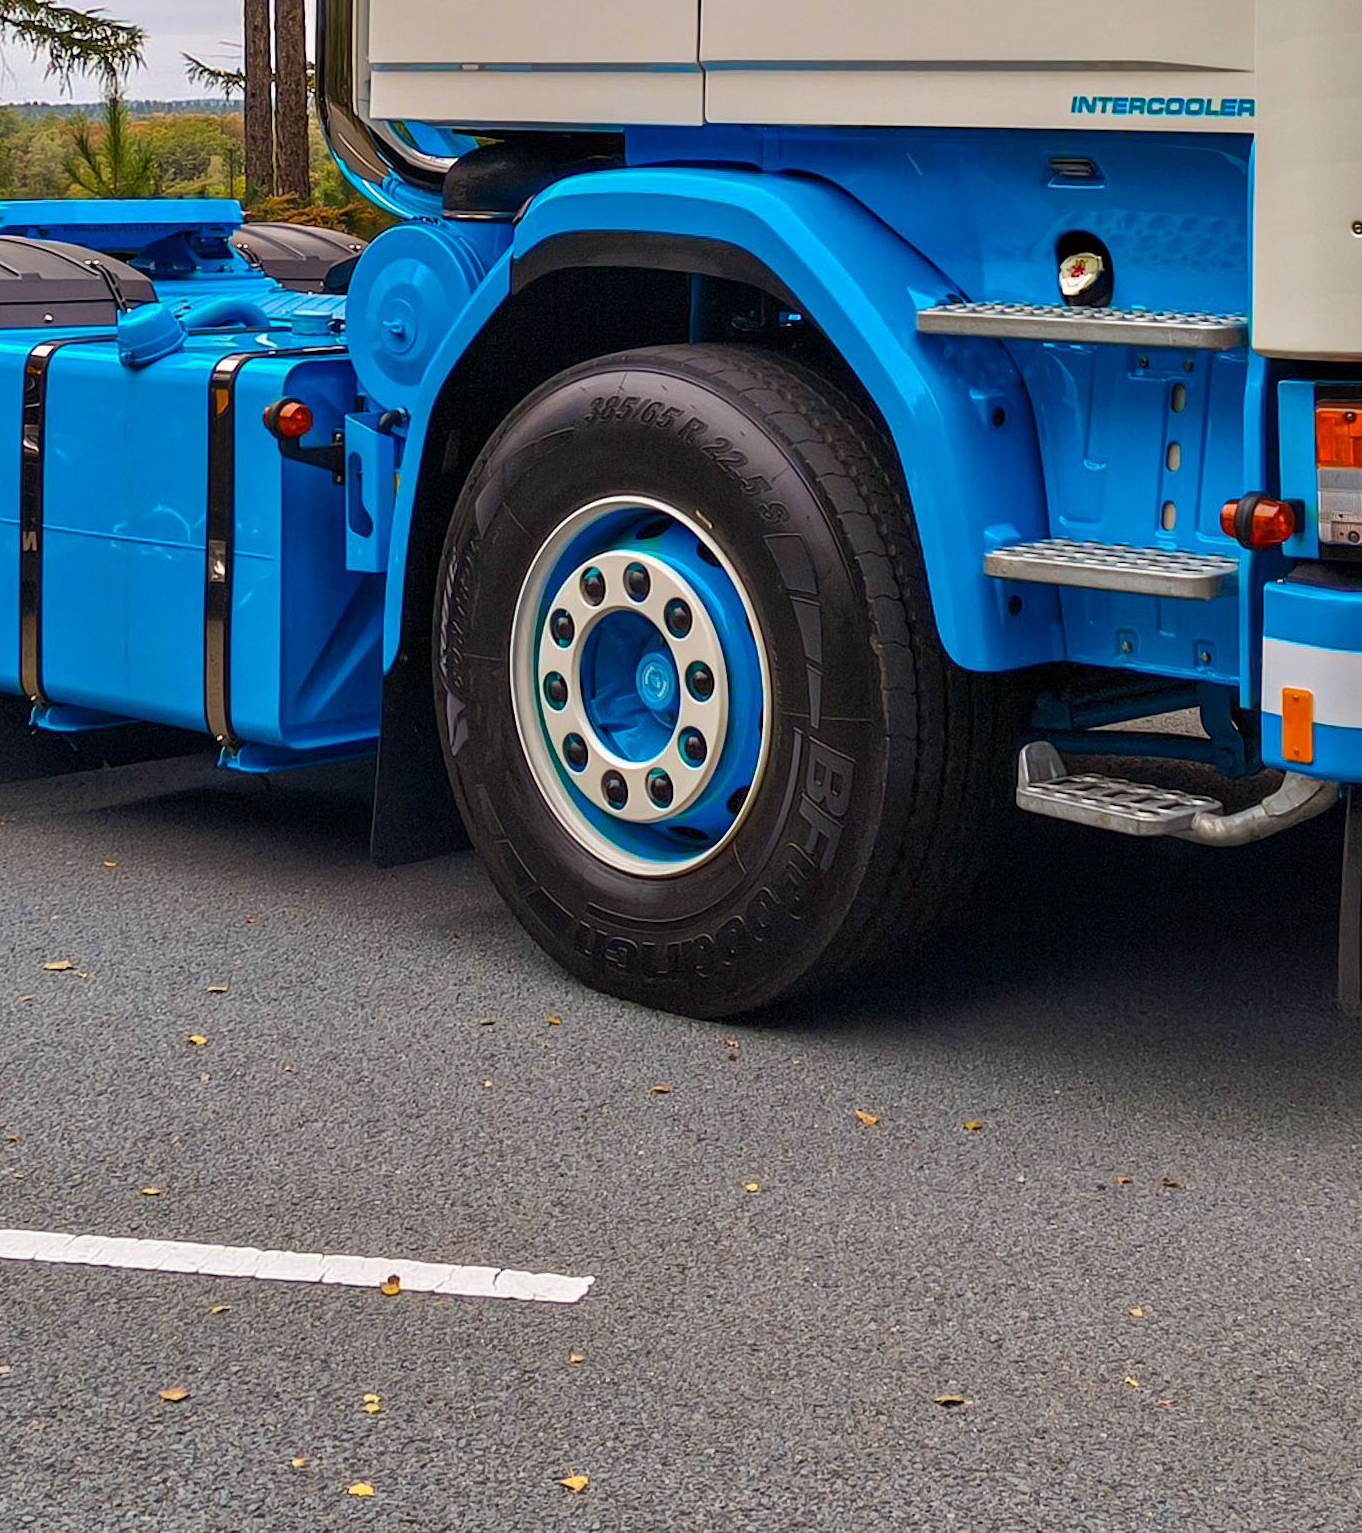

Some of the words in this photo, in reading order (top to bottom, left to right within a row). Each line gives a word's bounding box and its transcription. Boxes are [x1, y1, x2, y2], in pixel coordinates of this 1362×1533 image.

[1070, 95, 1256, 117] INTERCOOLER
[583, 395, 683, 430] 385/65
[677, 416, 709, 445] R
